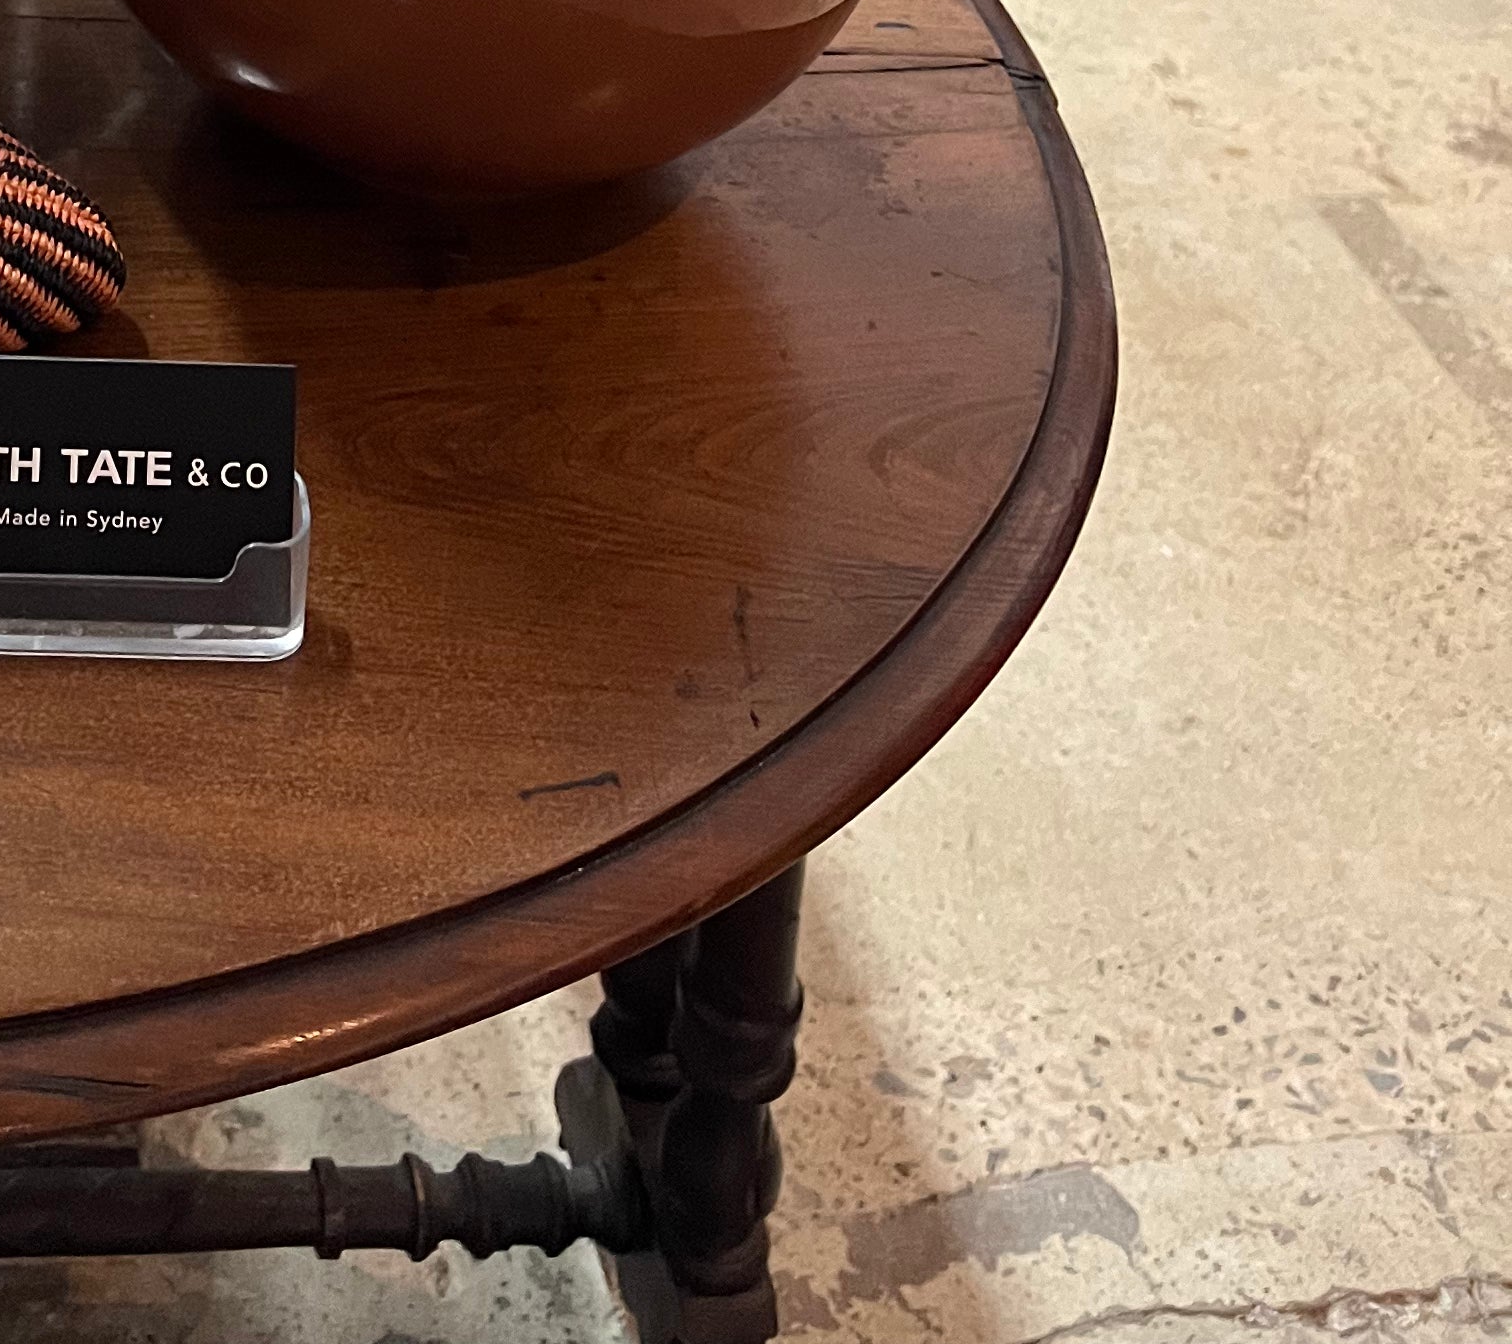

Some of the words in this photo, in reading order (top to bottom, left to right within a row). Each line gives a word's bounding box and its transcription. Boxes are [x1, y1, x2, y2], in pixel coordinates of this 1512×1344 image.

[60, 448, 173, 486] TATE
[187, 457, 210, 487] &
[220, 461, 269, 489] CO
[59, 509, 78, 527] in
[86, 509, 164, 534] Sydney
